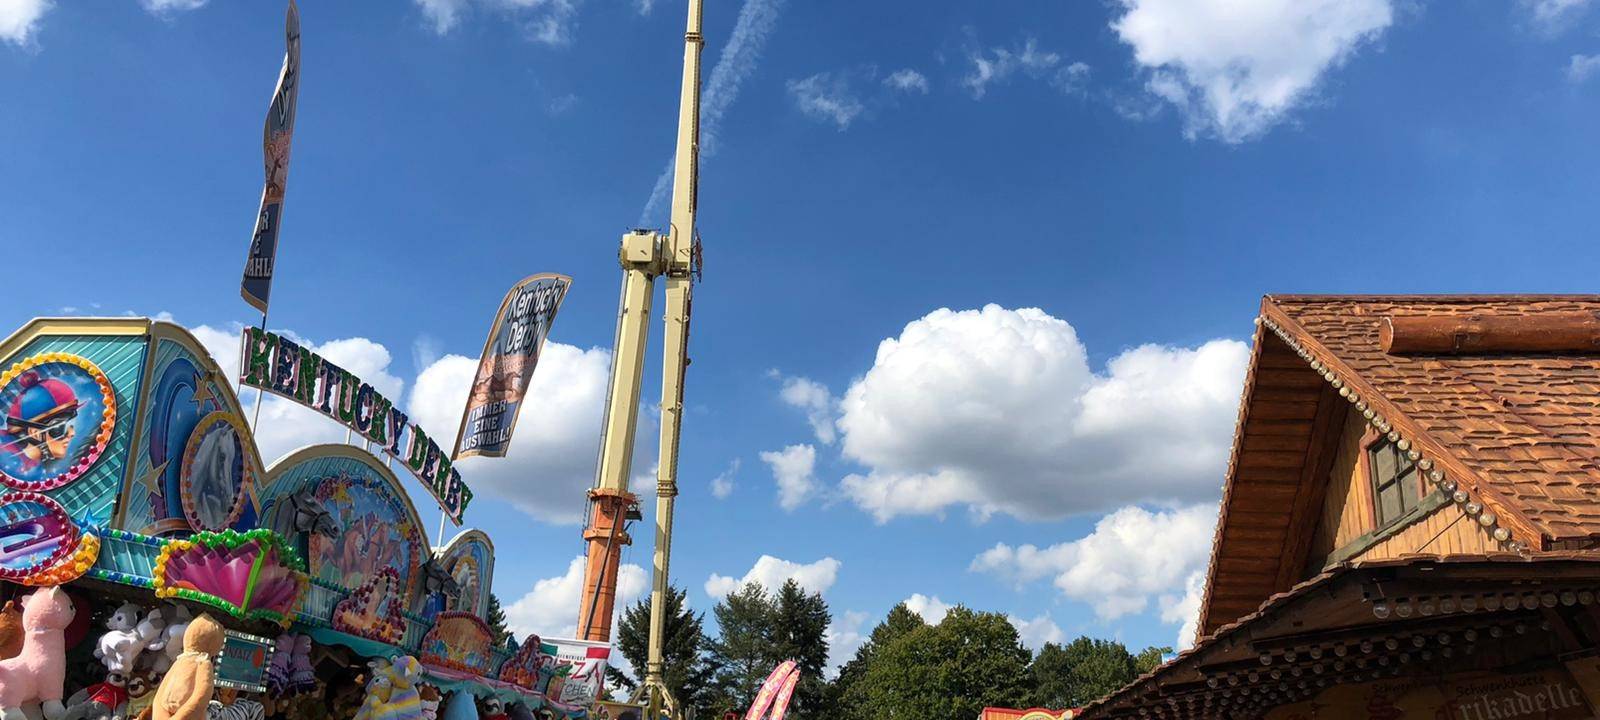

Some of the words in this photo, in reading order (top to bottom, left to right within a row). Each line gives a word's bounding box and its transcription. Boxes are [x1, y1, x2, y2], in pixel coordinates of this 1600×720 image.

[508, 279, 565, 321] Kentucky
[506, 323, 541, 355] Derby
[240, 326, 408, 455] KENTUCKY
[405, 423, 474, 525] DERBY
[472, 400, 506, 422] IMMER
[461, 426, 511, 453] AUSWAHL!
[473, 416, 499, 436] EINE
